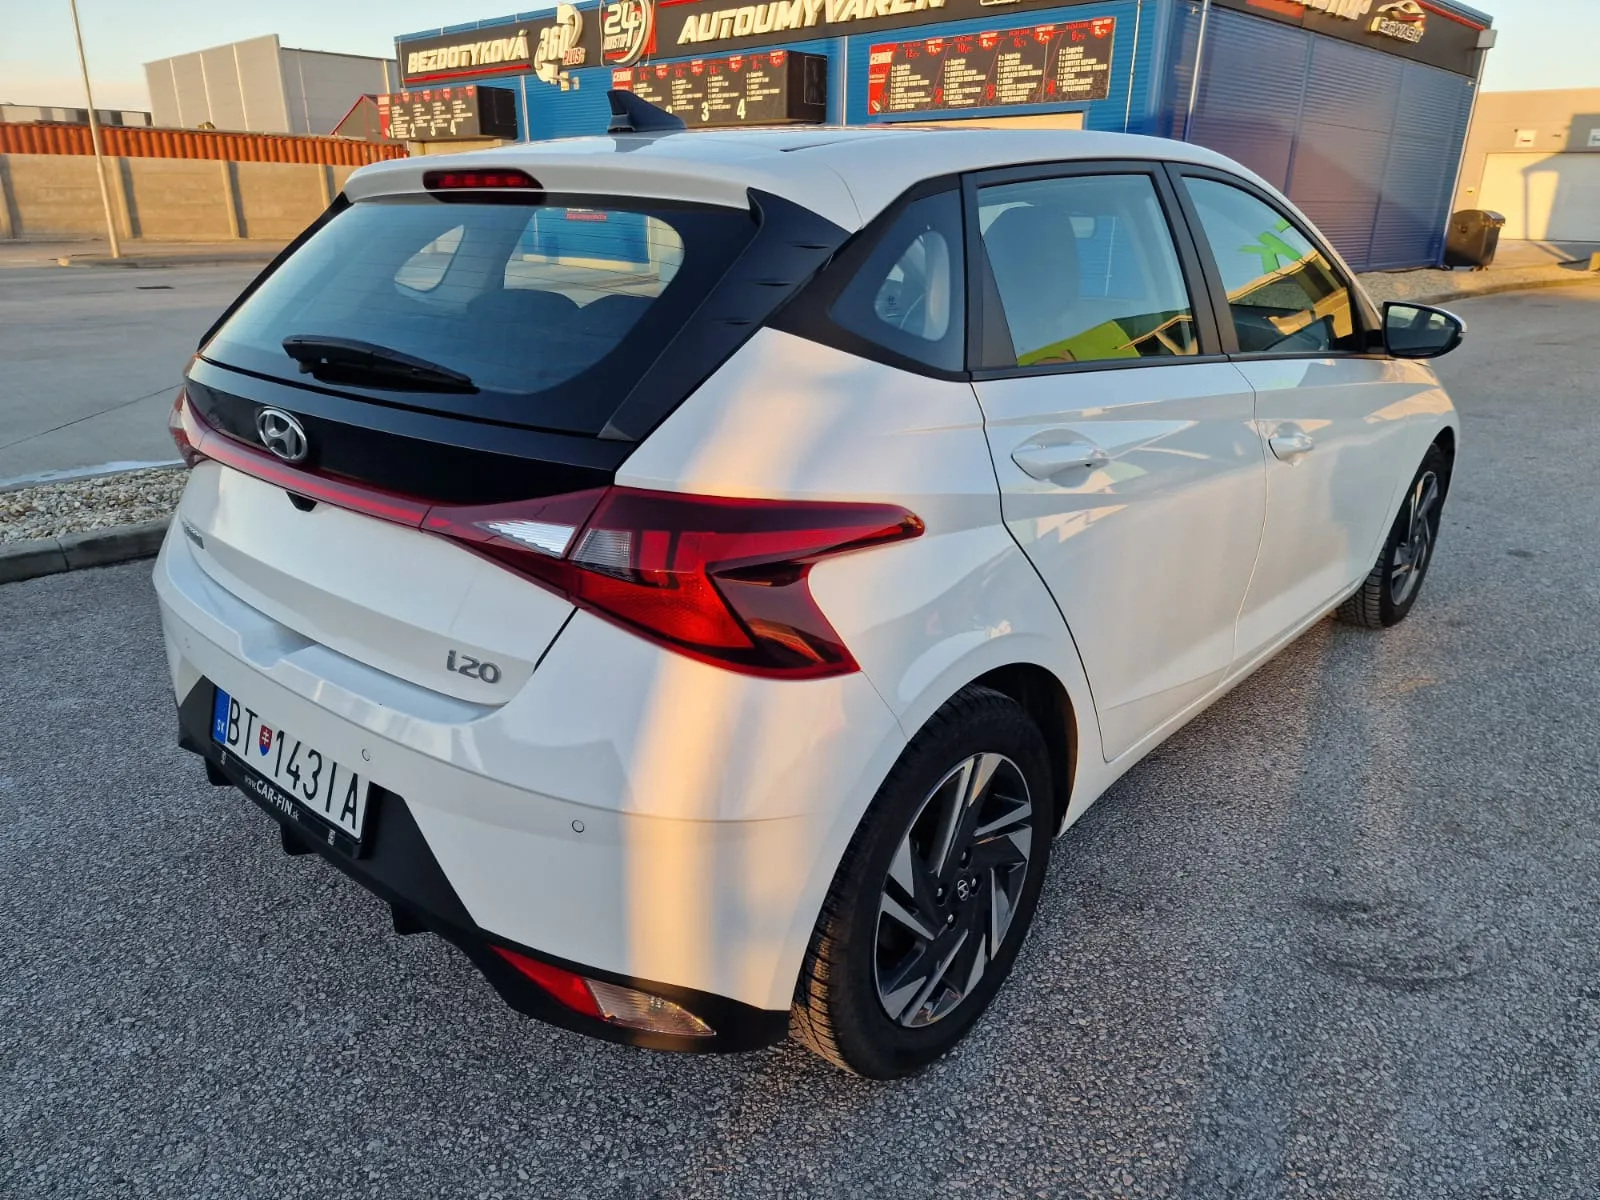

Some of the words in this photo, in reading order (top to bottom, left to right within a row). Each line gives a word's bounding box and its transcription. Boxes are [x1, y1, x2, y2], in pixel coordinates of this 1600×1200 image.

[407, 30, 529, 74] BEZDOTYKOVÁ
[538, 25, 574, 61] 360
[701, 101, 709, 121] 3
[736, 98, 746, 119] 4
[216, 718, 226, 735] SK
